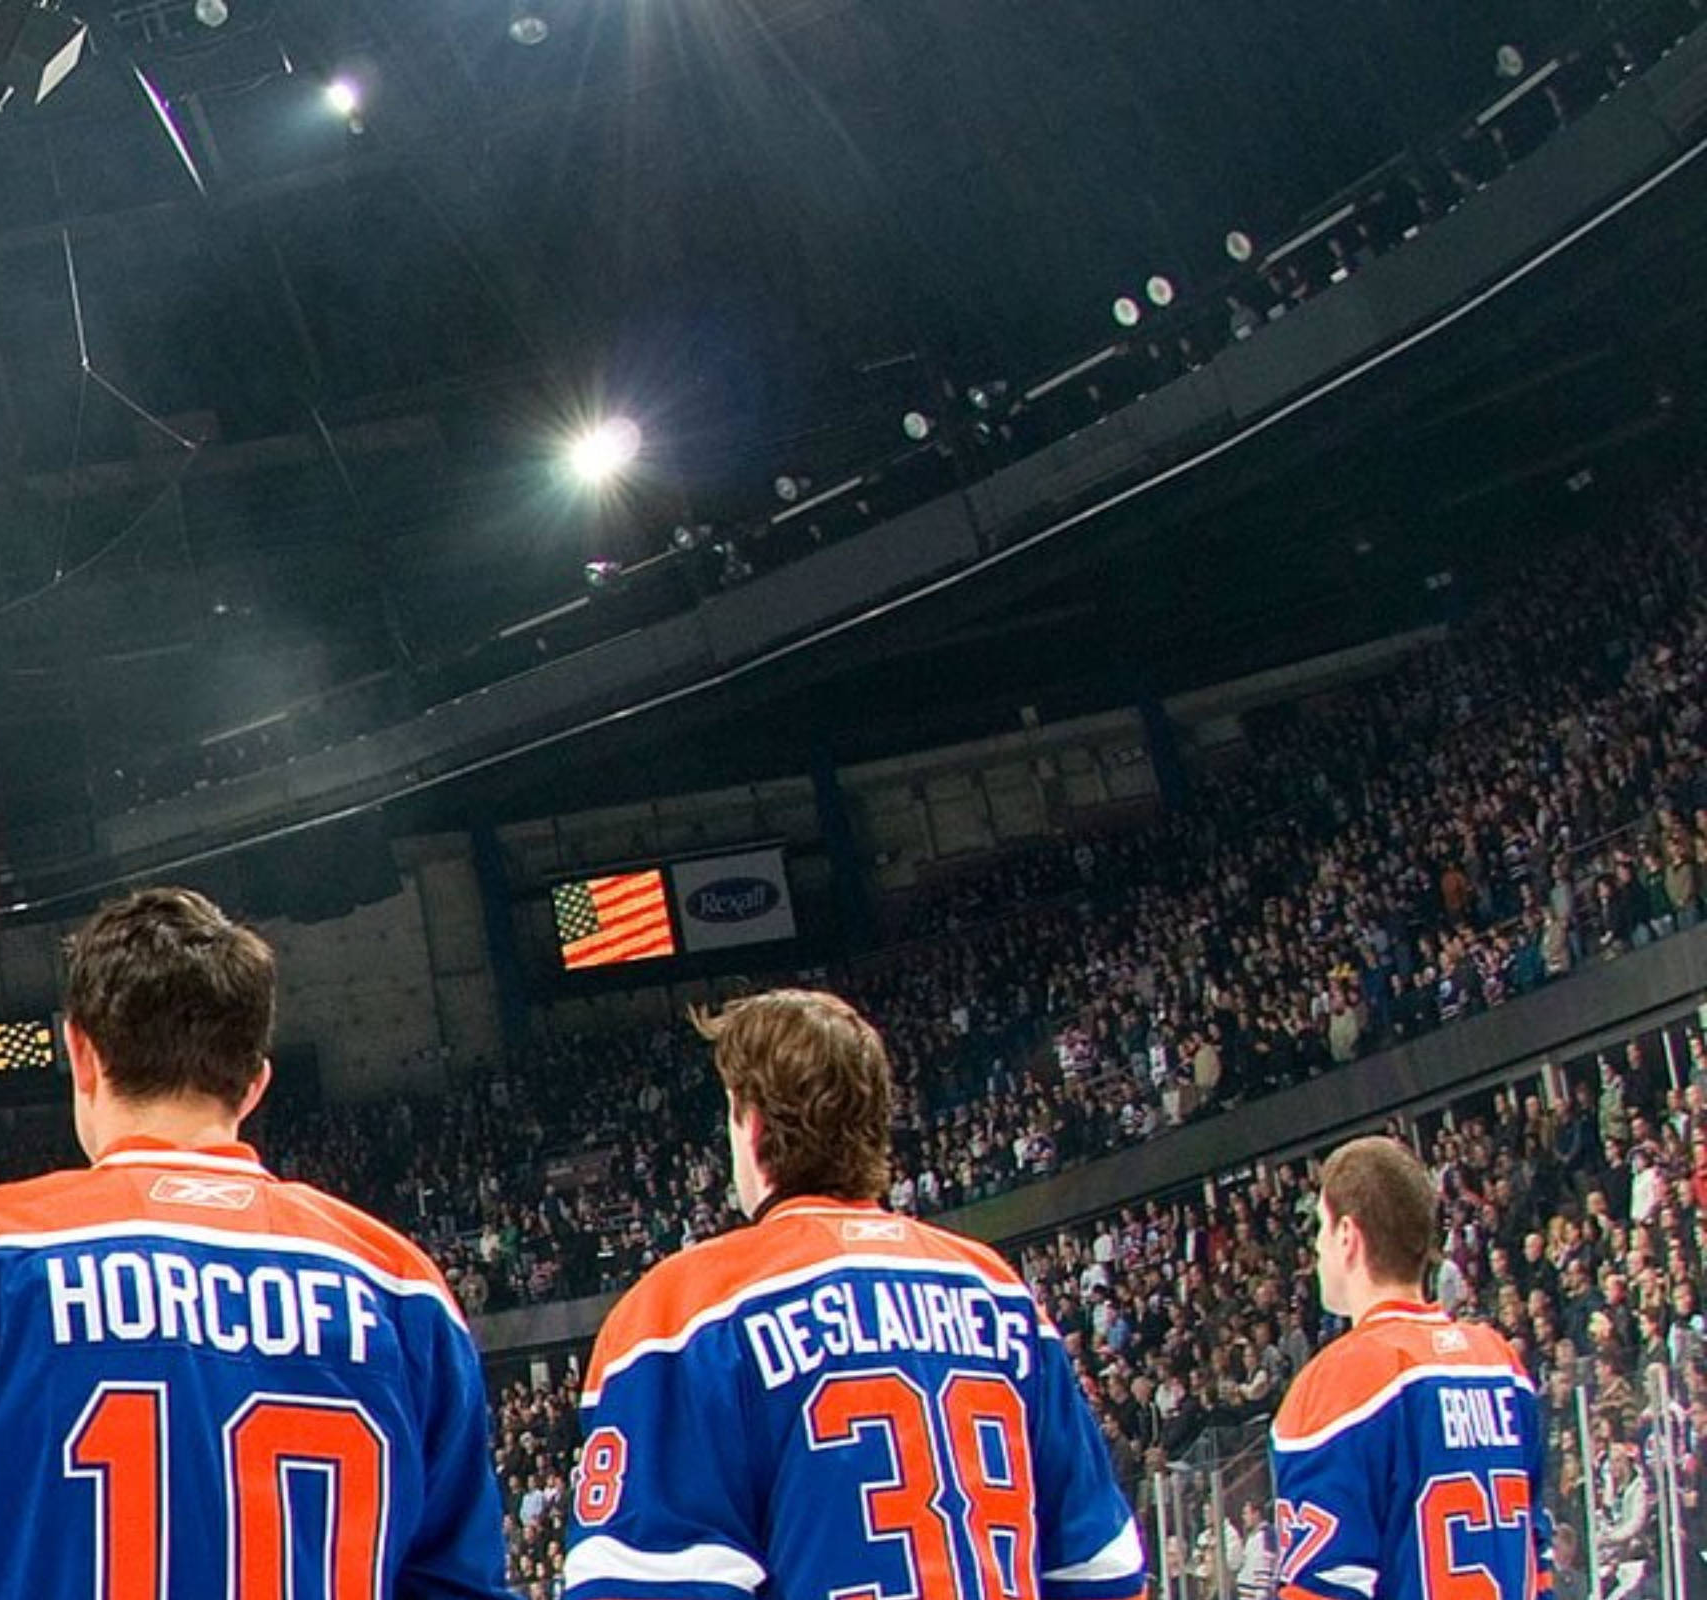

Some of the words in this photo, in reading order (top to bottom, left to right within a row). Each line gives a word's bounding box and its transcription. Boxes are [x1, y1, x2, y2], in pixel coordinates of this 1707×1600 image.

[699, 884, 765, 918] Rexall
[46, 1250, 379, 1364] HORCOFF
[1438, 1386, 1520, 1449] BRULE
[574, 1426, 629, 1527] 8
